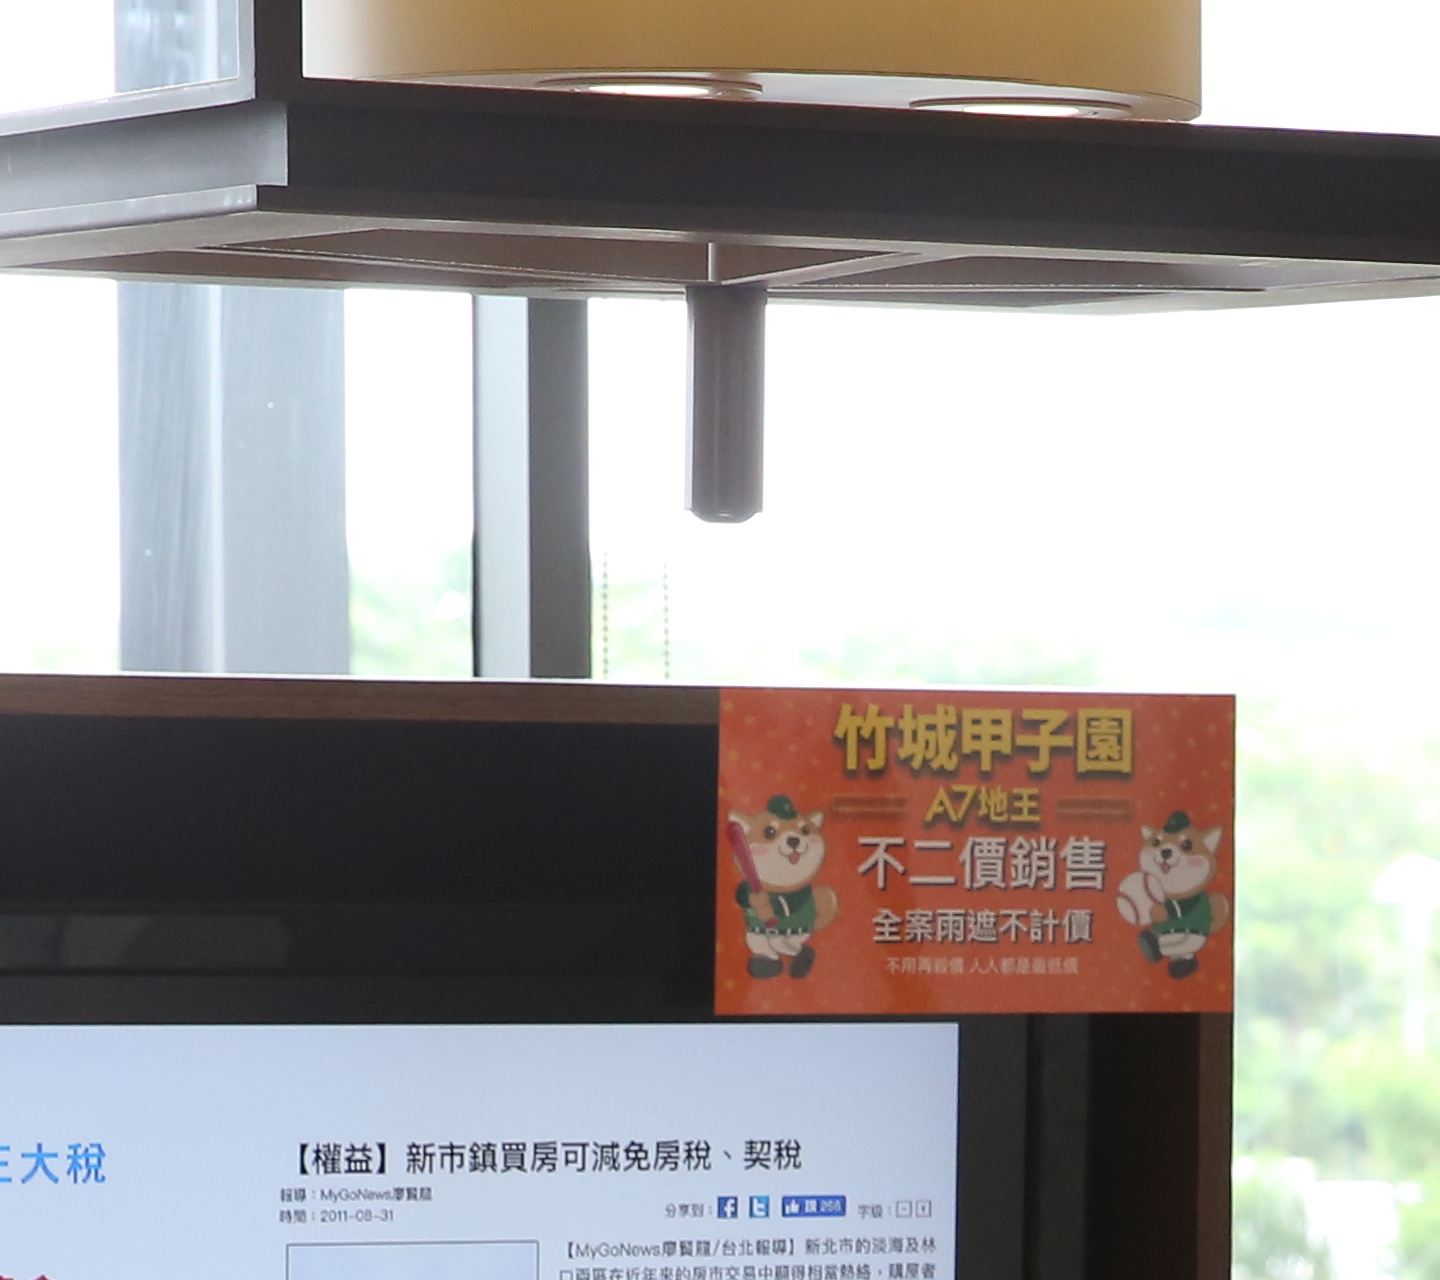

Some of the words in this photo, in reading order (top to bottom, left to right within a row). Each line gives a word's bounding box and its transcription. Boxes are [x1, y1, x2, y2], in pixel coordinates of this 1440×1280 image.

[835, 704, 1132, 775] 竹城甲子園
[925, 786, 1040, 823] A7地王
[857, 835, 1107, 890] 不二價銷售
[872, 908, 1093, 944] 全案雨遮不計價
